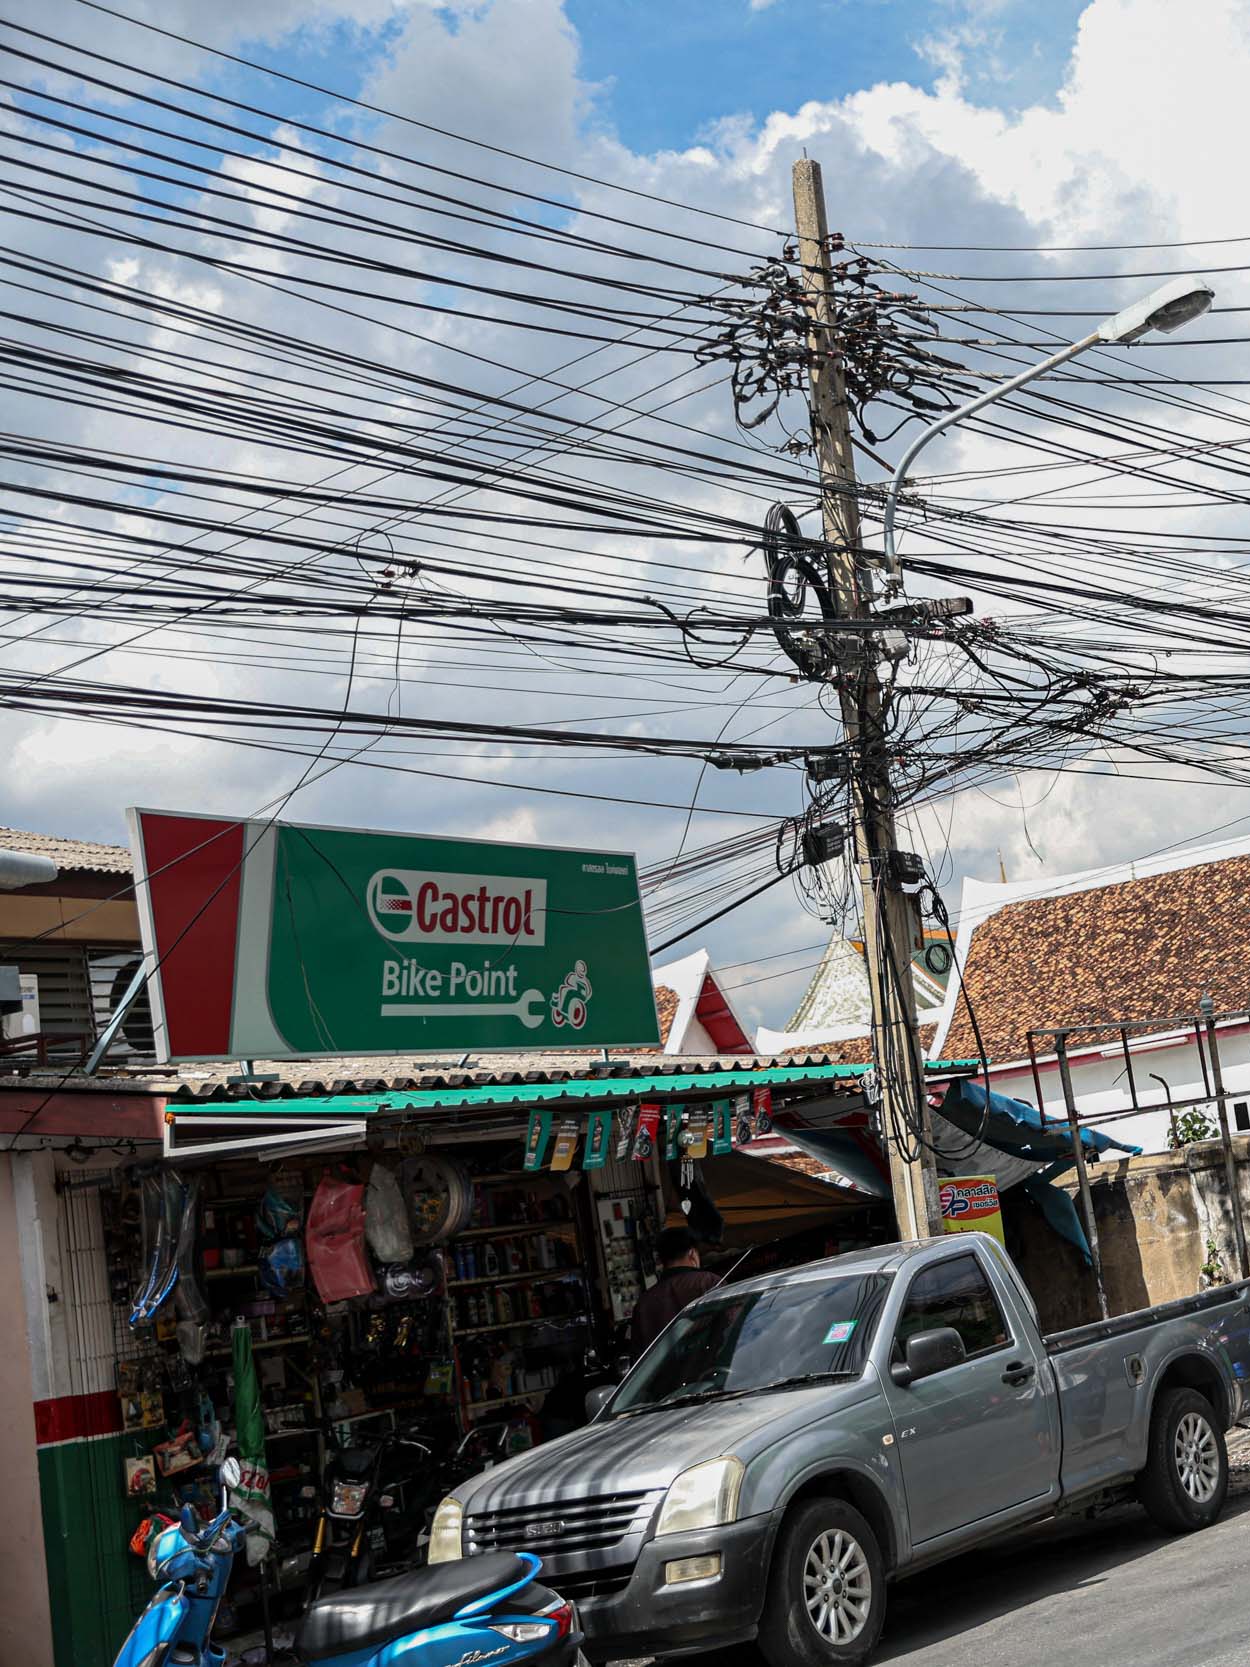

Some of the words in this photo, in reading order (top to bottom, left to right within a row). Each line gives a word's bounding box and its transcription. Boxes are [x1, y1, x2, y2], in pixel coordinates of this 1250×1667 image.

[416, 881, 535, 936] Castrol
[382, 958, 443, 997] Bike
[450, 960, 518, 997] Point
[901, 1427, 916, 1438] EX
